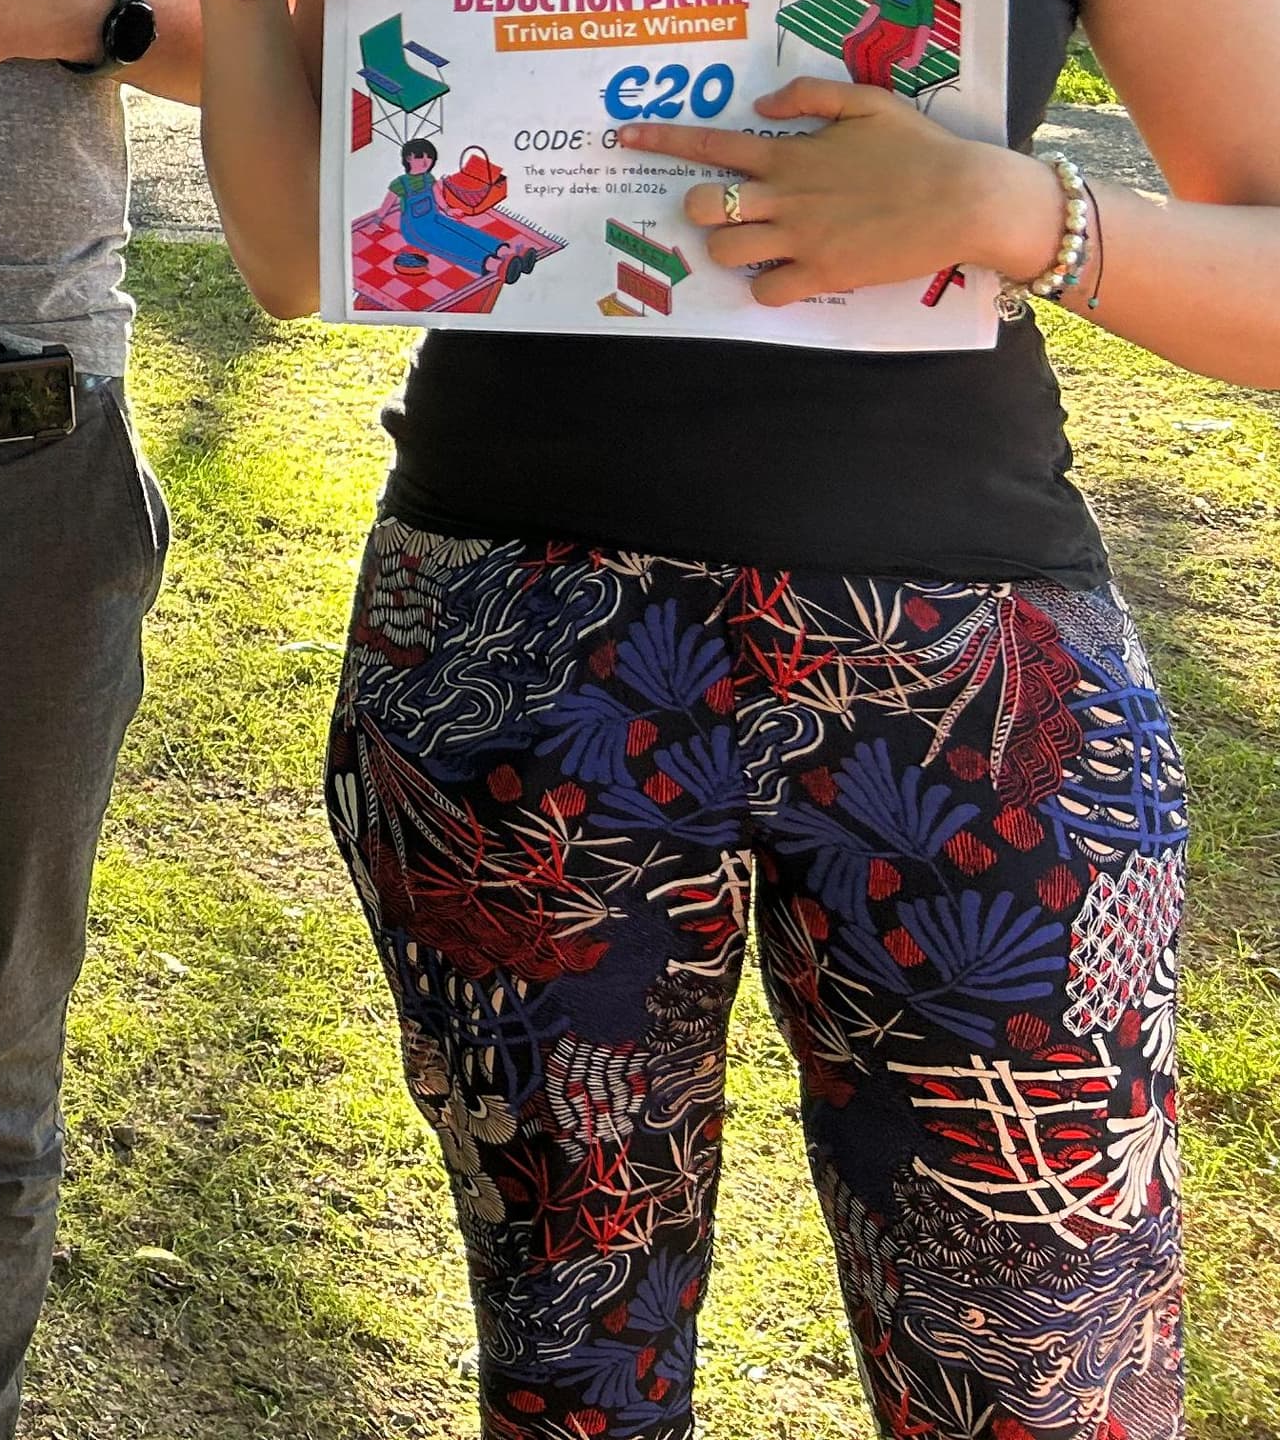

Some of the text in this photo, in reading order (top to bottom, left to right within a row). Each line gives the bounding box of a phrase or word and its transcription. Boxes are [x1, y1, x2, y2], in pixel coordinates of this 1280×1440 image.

[503, 15, 737, 43] Trivia Quiz Winner
[600, 63, 734, 120] €20
[514, 129, 592, 151] CODE:
[524, 166, 546, 177] The
[550, 165, 600, 177] voucher
[606, 165, 617, 176] is
[622, 164, 695, 177] redeemable
[701, 167, 712, 178] in
[525, 182, 667, 196] Expiry date: 01.01.2026
